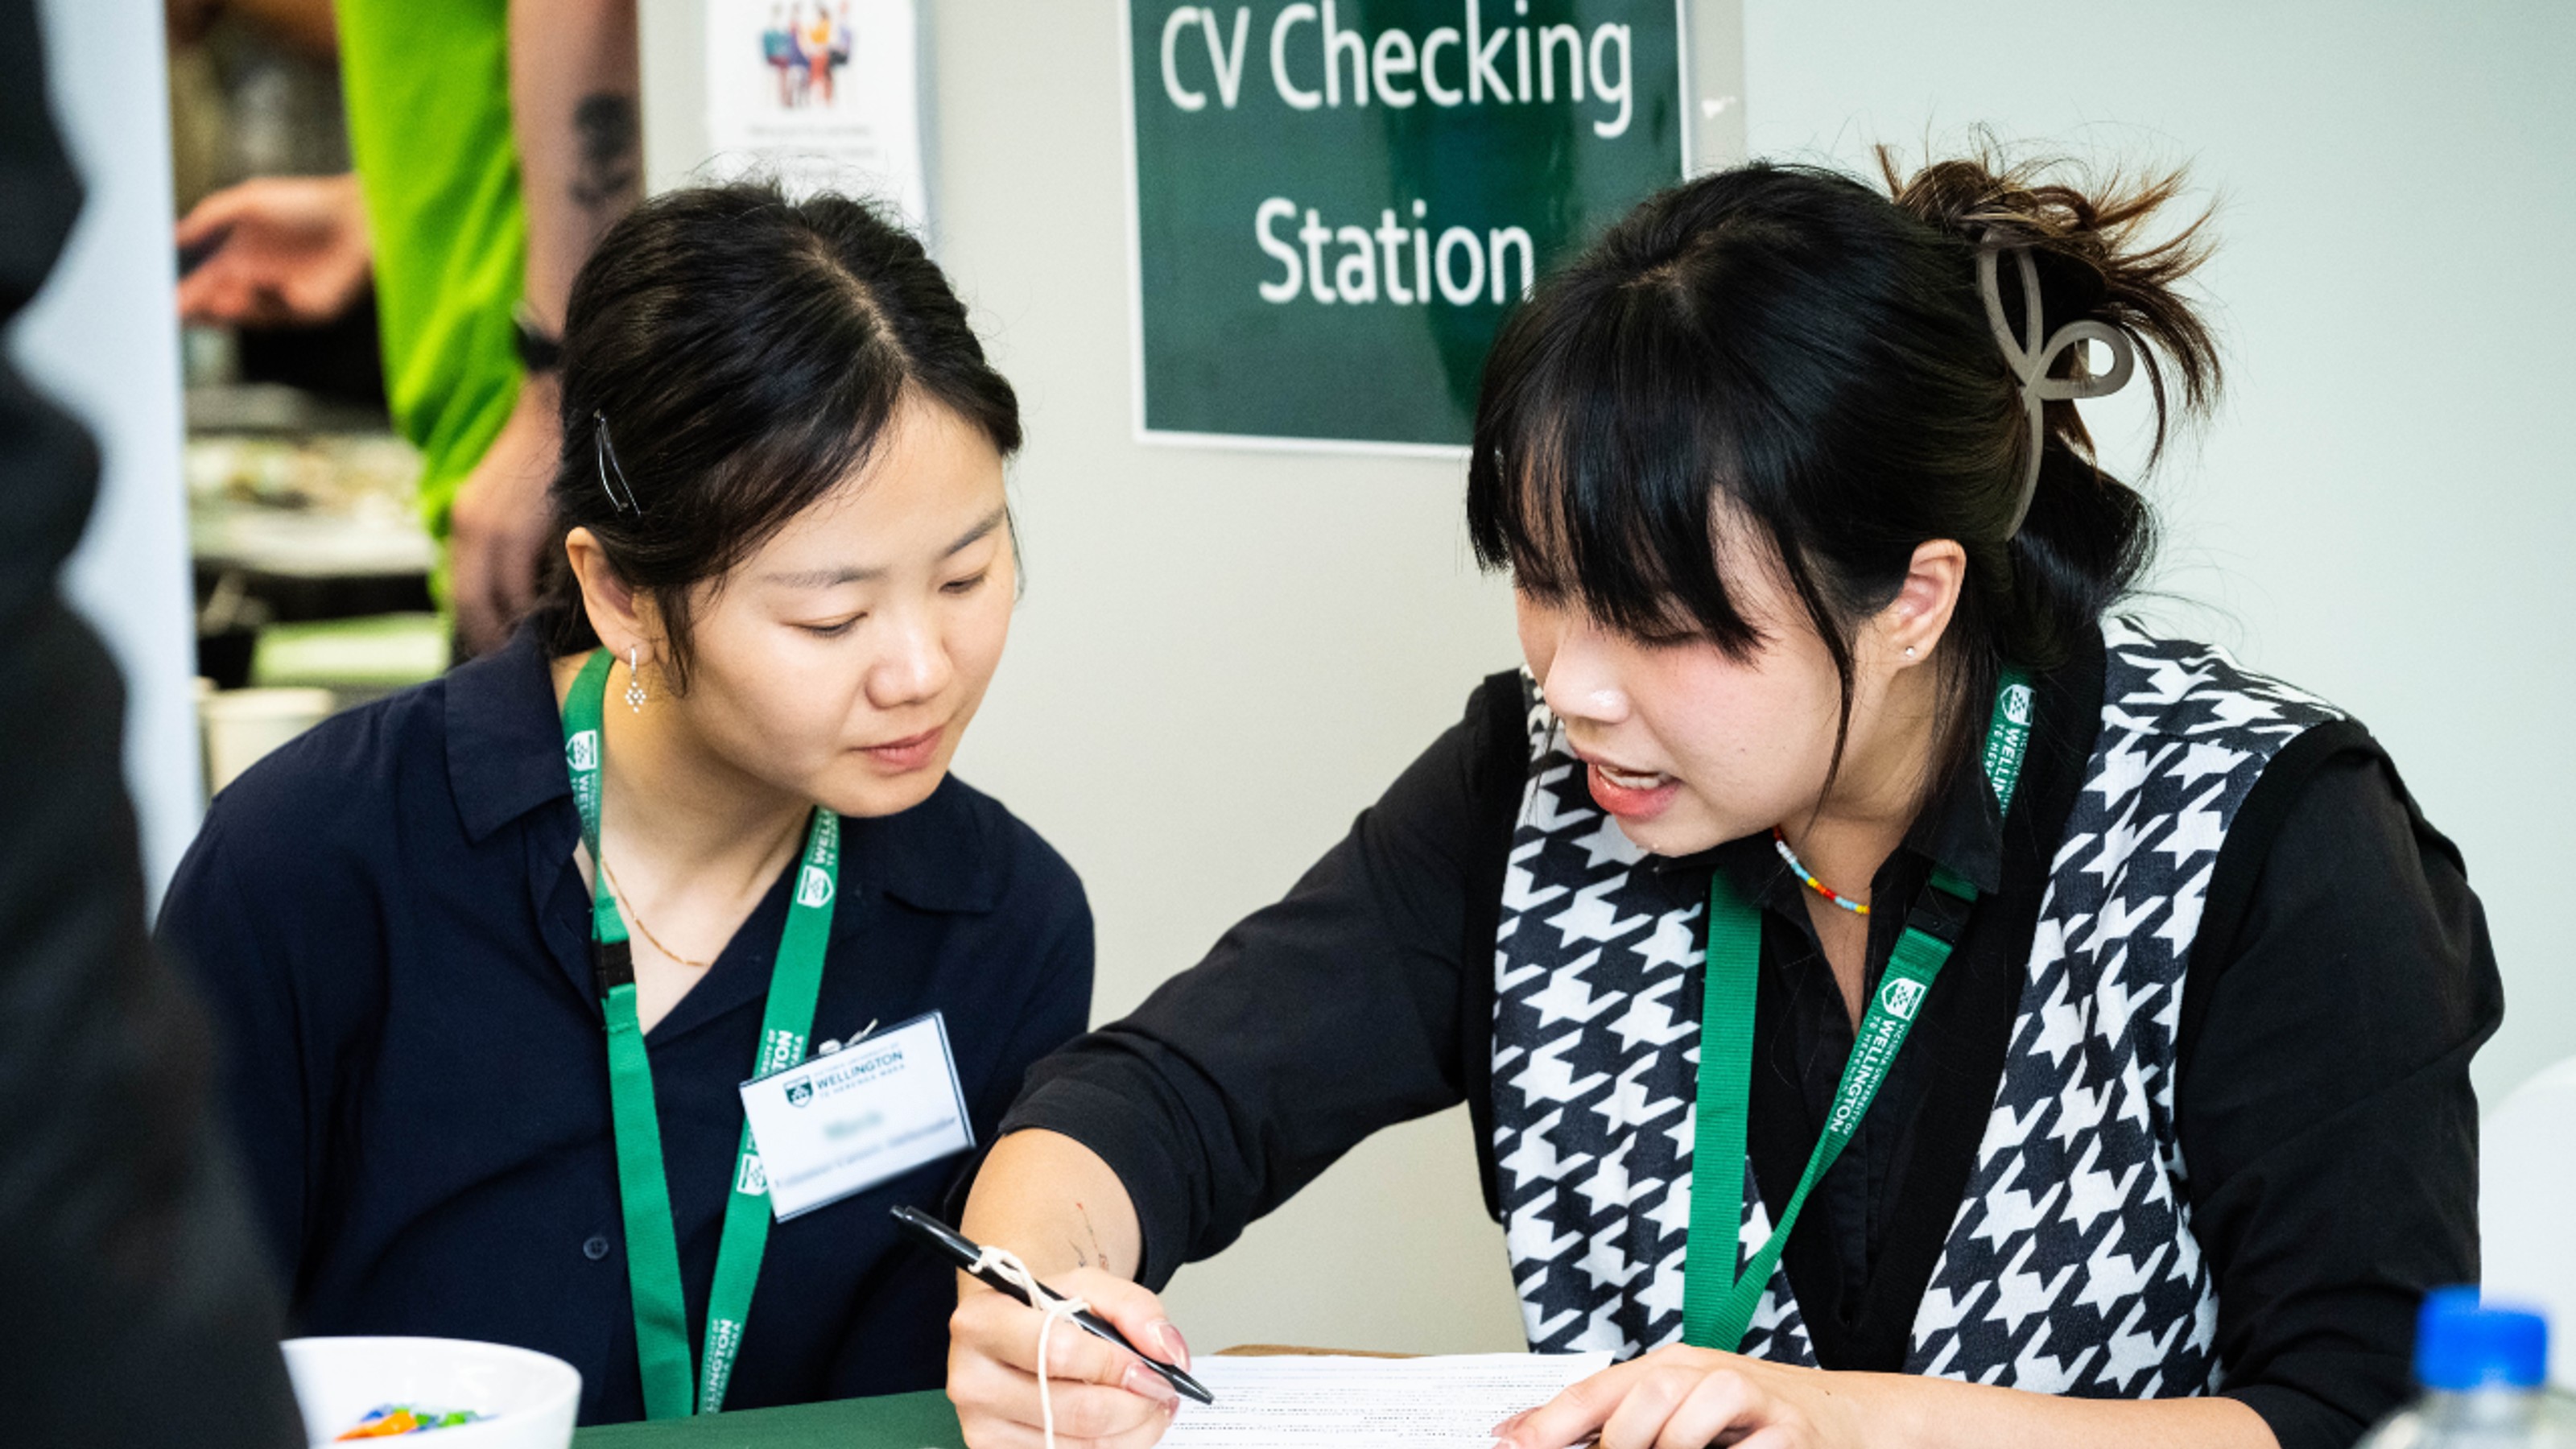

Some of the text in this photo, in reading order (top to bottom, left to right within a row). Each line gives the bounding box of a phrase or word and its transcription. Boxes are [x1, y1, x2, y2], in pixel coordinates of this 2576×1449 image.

[1161, 0, 1633, 138] CV Checking
[1255, 197, 1535, 306] Station
[816, 1051, 902, 1090] WELLINGTON
[1830, 1019, 1897, 1133] WELLINGTON
